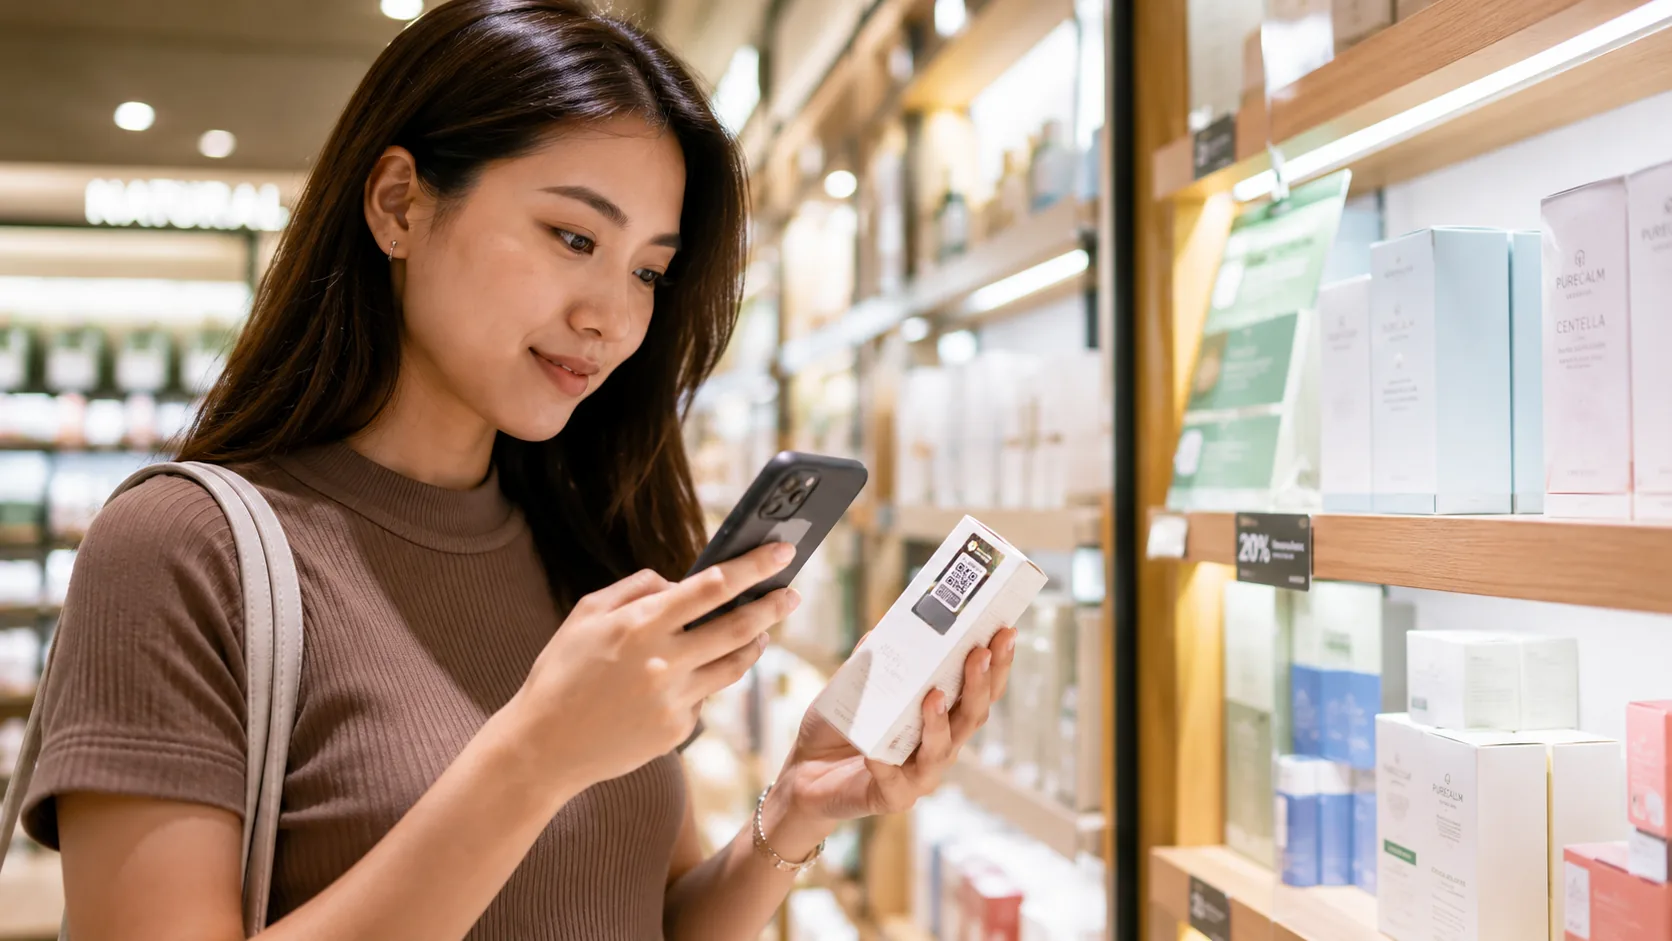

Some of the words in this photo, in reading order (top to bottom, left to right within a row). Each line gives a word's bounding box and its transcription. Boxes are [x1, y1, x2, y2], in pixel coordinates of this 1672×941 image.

[1556, 268, 1605, 289] PURECALM
[1556, 314, 1606, 334] CENTELLA
[1239, 532, 1271, 564] 20%
